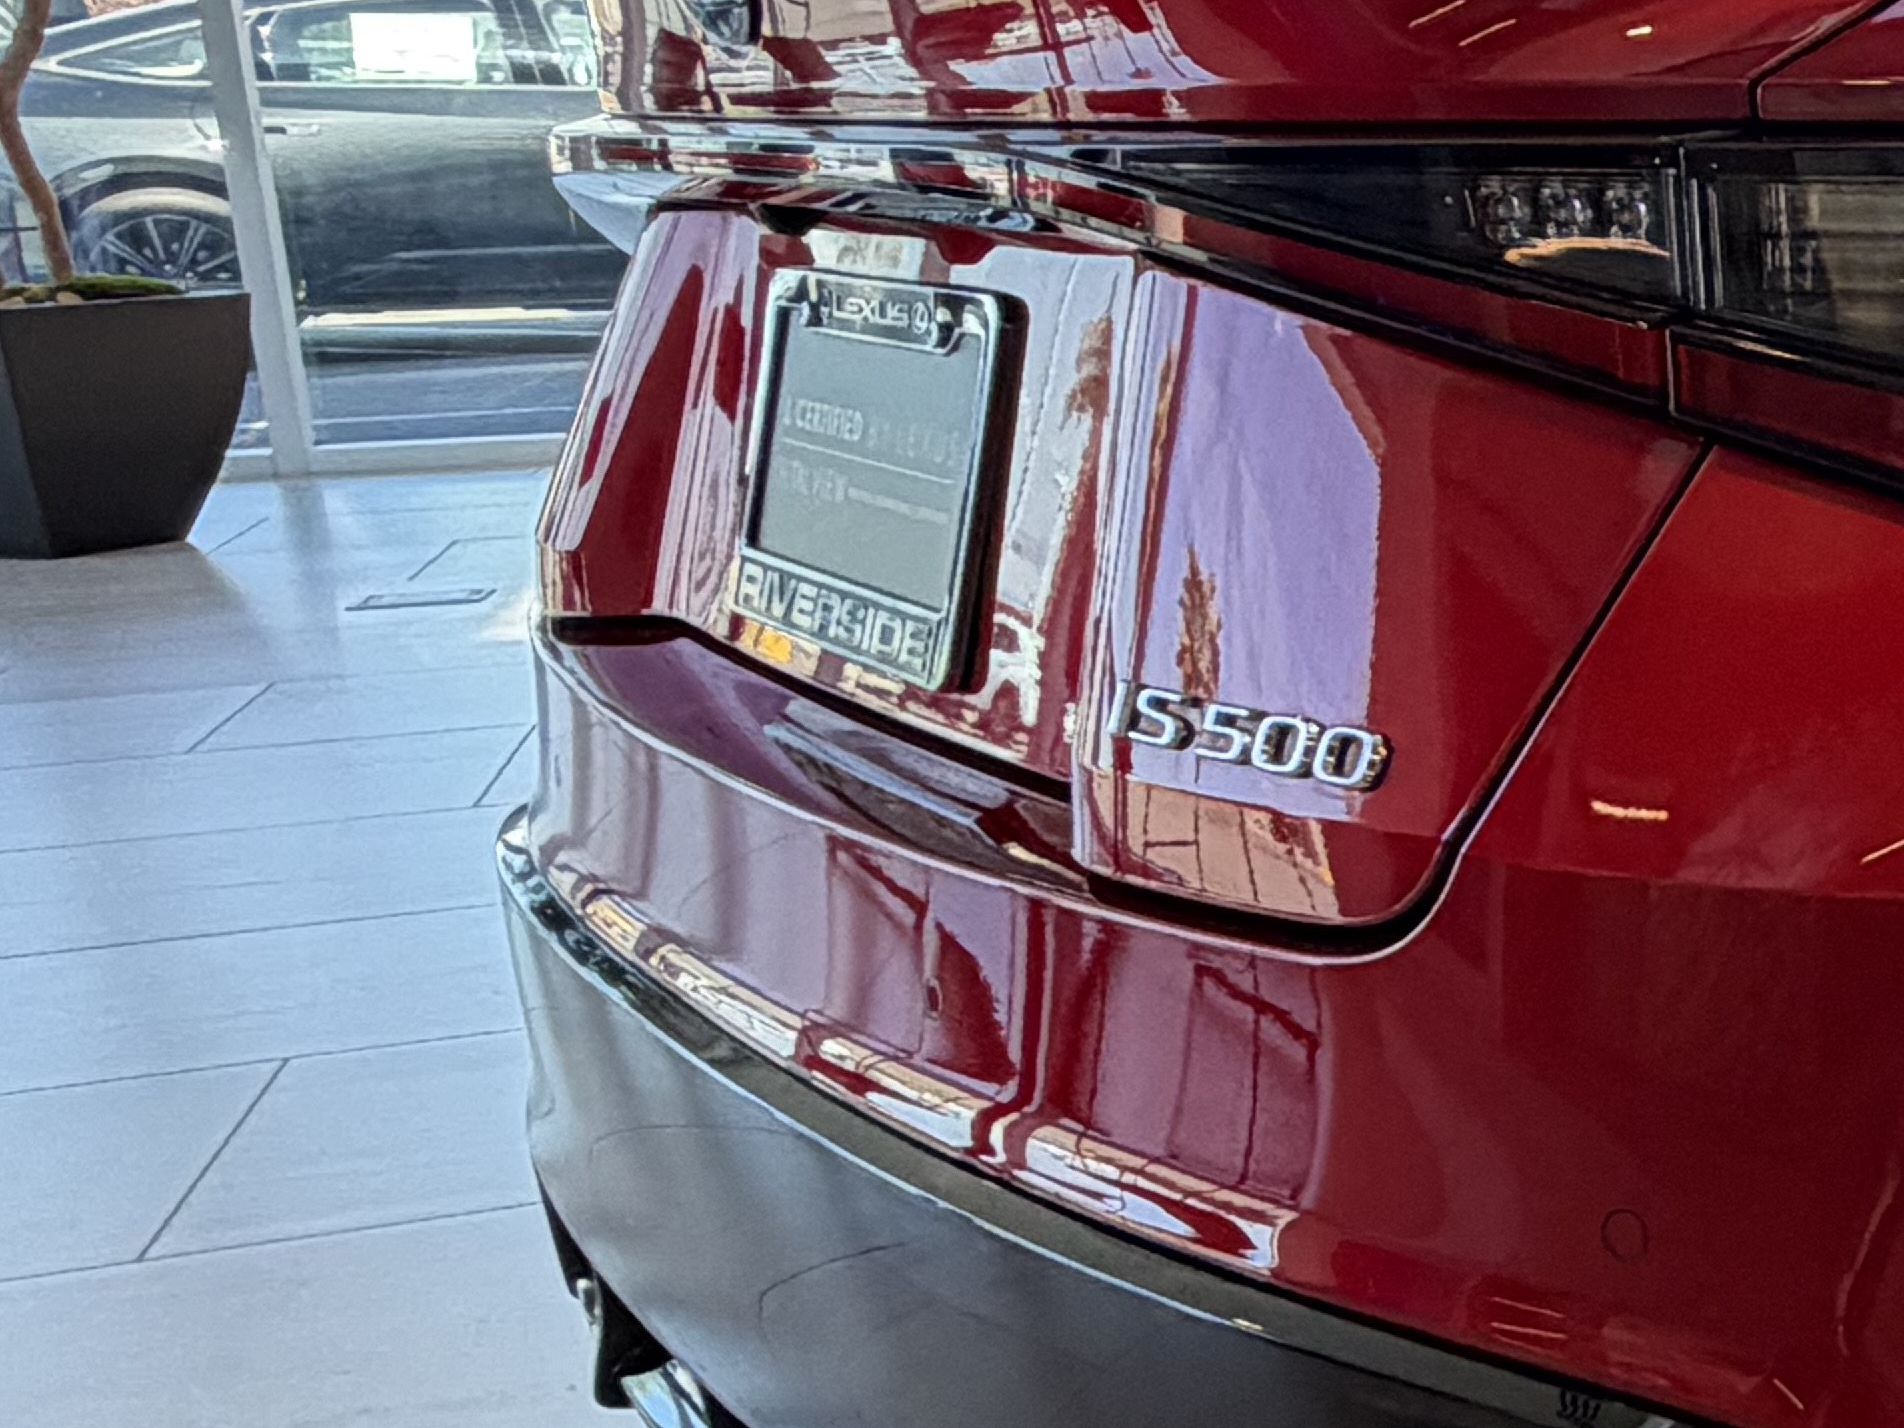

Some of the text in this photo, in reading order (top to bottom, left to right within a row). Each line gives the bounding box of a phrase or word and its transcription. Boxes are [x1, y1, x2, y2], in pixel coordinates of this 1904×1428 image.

[831, 289, 910, 328] LEXUS
[738, 561, 930, 673] RIVERSIDE
[1108, 680, 1387, 790] IS 500
